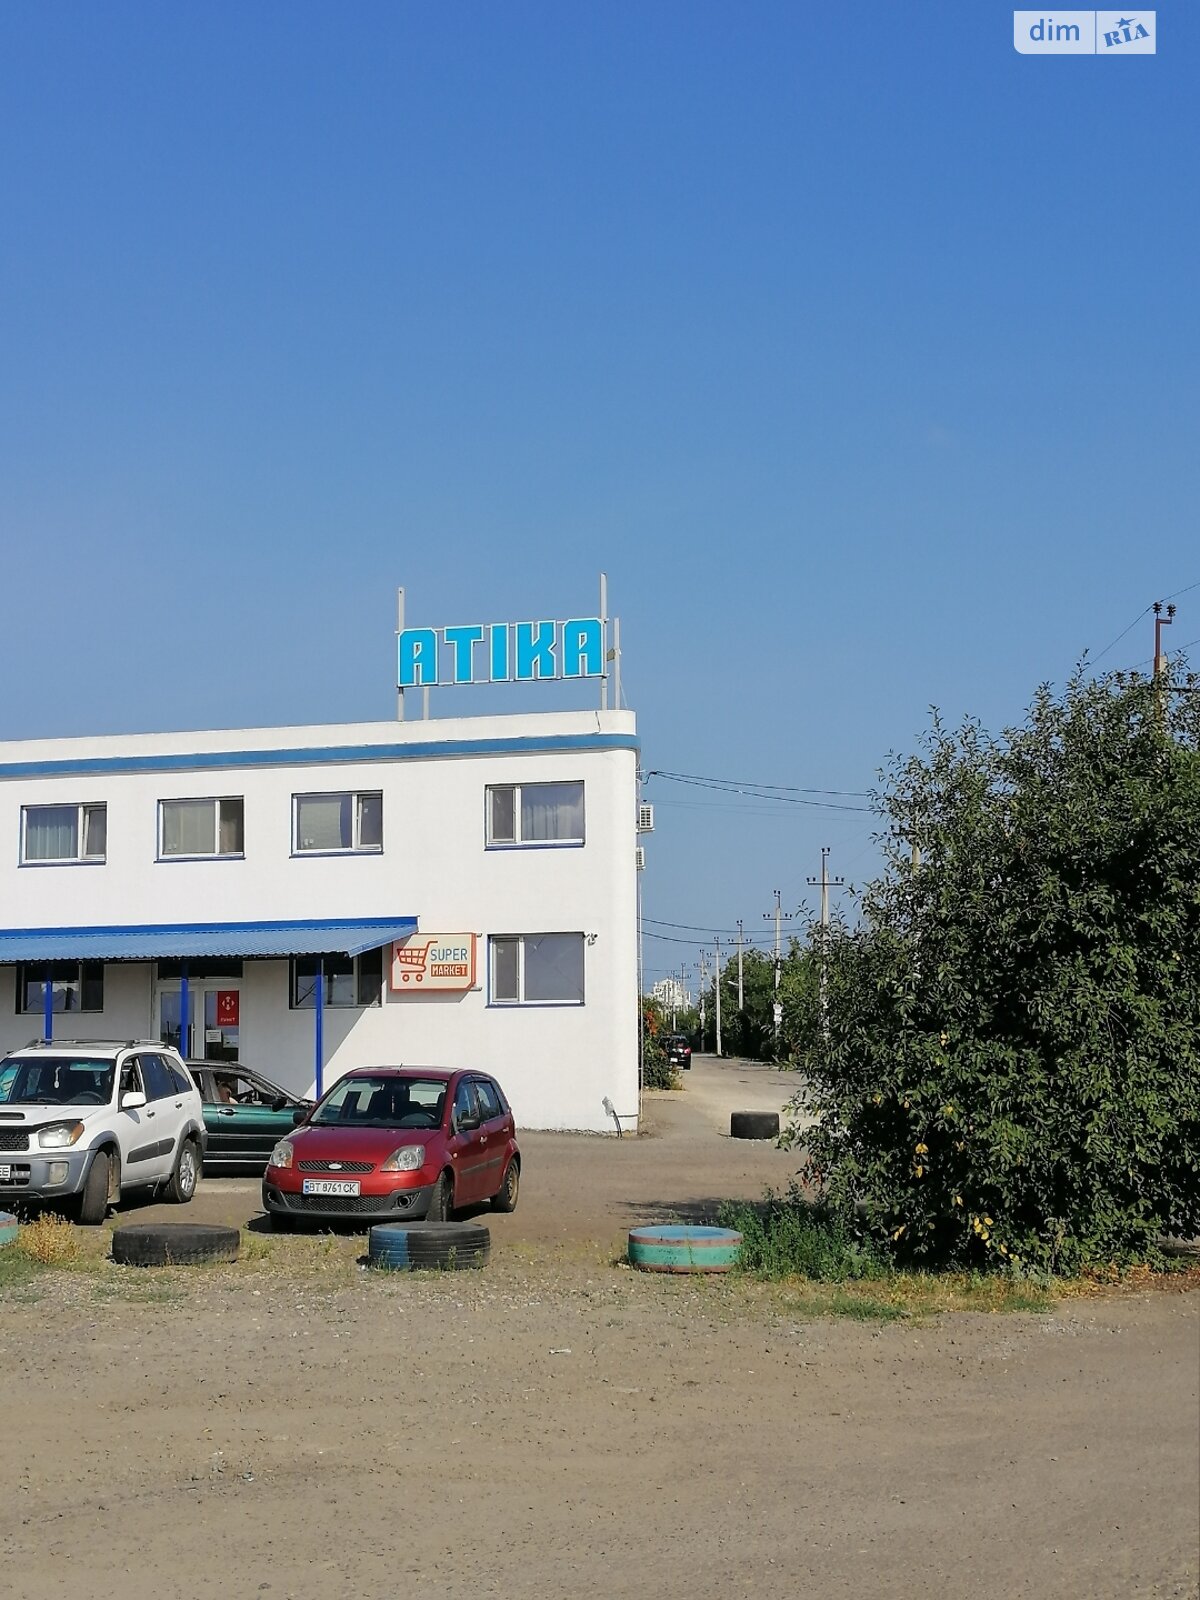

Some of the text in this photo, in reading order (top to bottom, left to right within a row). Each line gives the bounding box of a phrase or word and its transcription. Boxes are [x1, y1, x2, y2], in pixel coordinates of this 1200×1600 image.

[430, 948, 468, 961] SUPER
[431, 965, 467, 976] MARKET
[309, 1183, 356, 1193] BT 8761 CK
